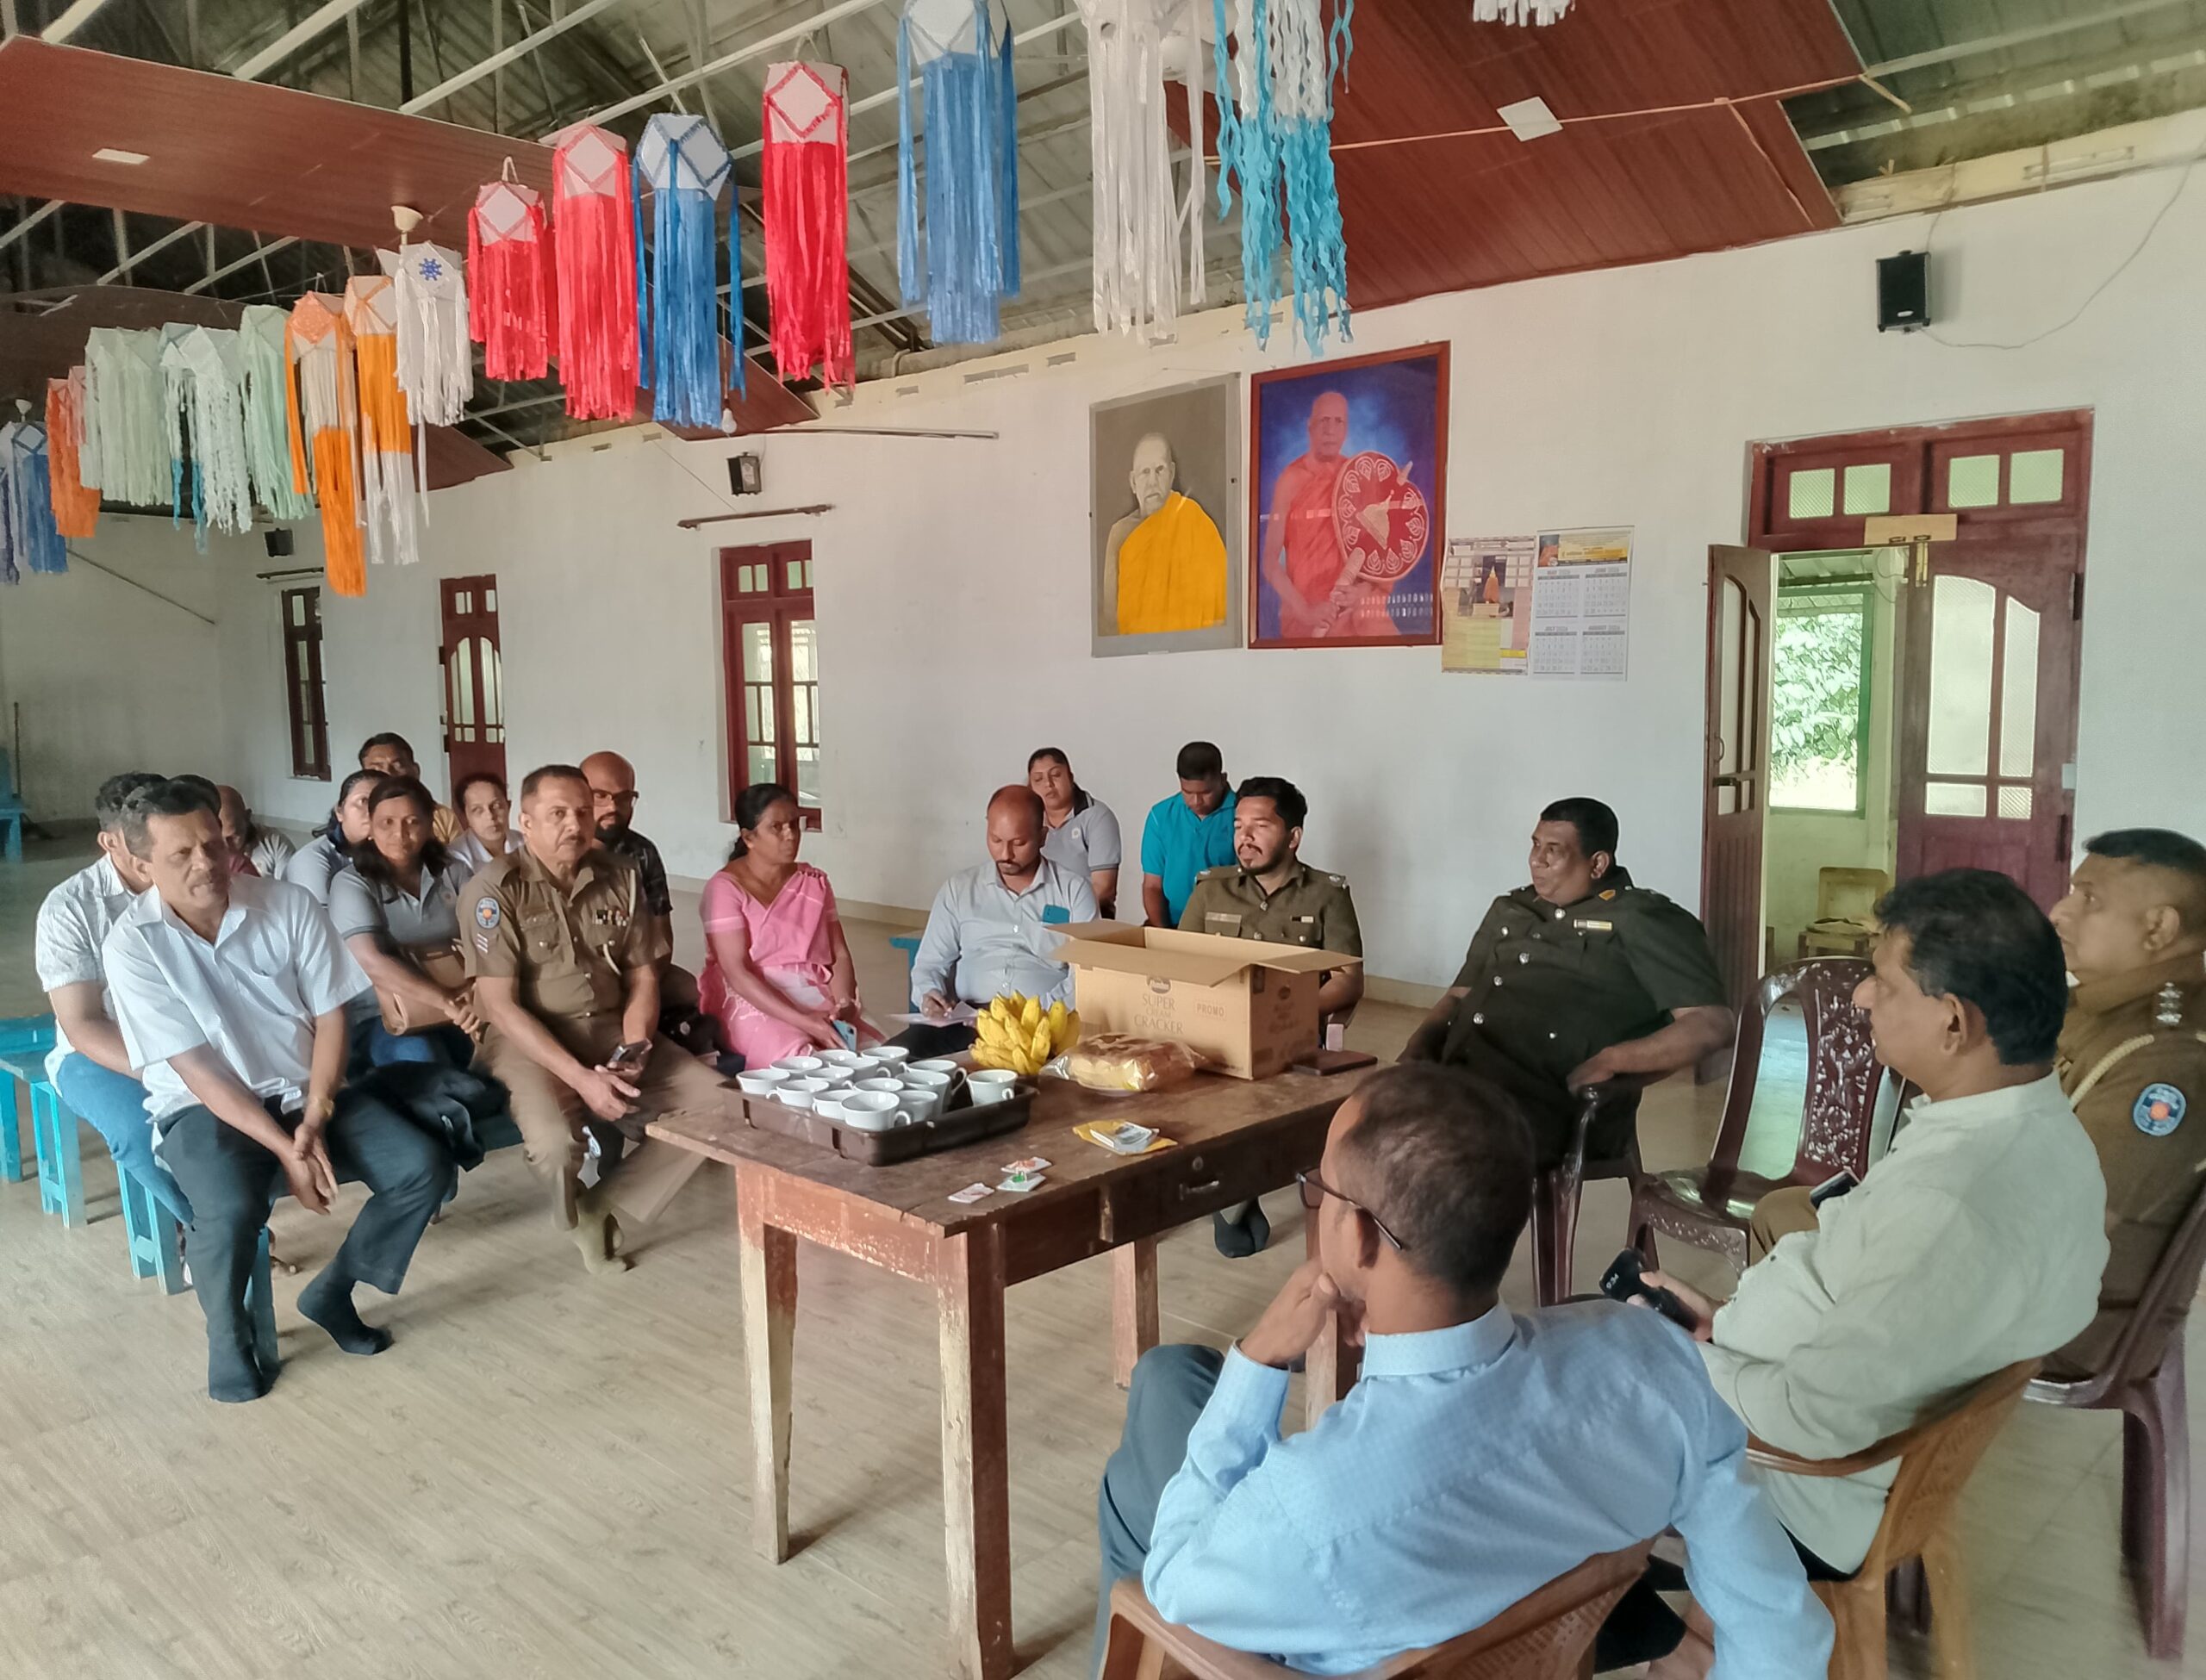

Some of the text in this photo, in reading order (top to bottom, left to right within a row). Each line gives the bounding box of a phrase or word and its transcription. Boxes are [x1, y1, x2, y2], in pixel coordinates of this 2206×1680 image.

[1142, 992, 1176, 1011] SUPER
[1196, 1003, 1225, 1017] PROMO
[1133, 1014, 1184, 1035] CRACKER
